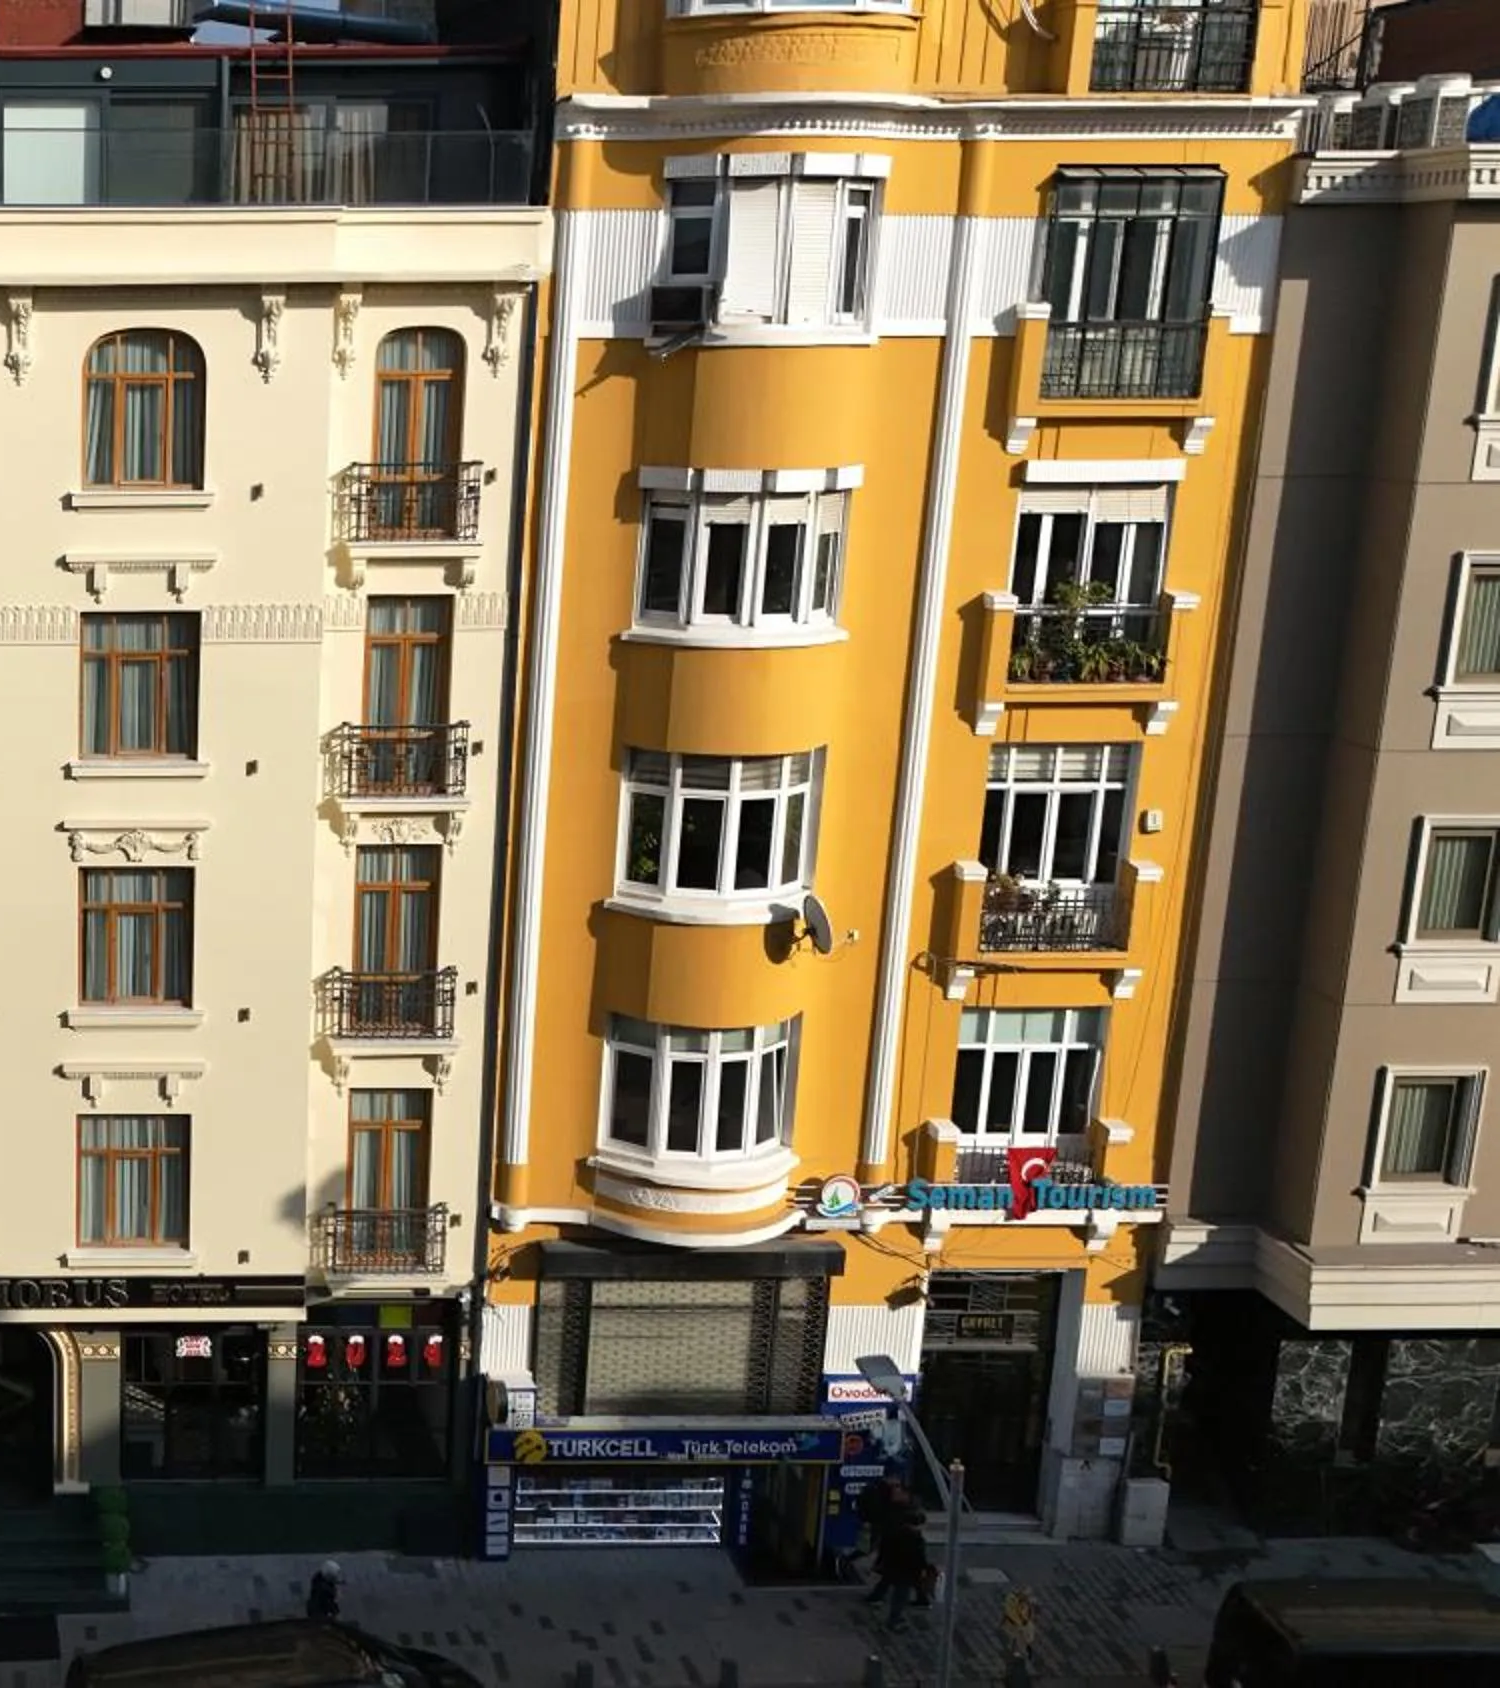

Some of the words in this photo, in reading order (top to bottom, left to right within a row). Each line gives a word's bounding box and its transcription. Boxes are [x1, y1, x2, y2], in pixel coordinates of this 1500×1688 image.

[907, 1177, 1014, 1210] Seman
[1031, 1177, 1157, 1210] Tourism
[550, 1439, 658, 1457] TURKCELL
[682, 1439, 719, 1456] Türk
[725, 1438, 797, 1456] Telekom
